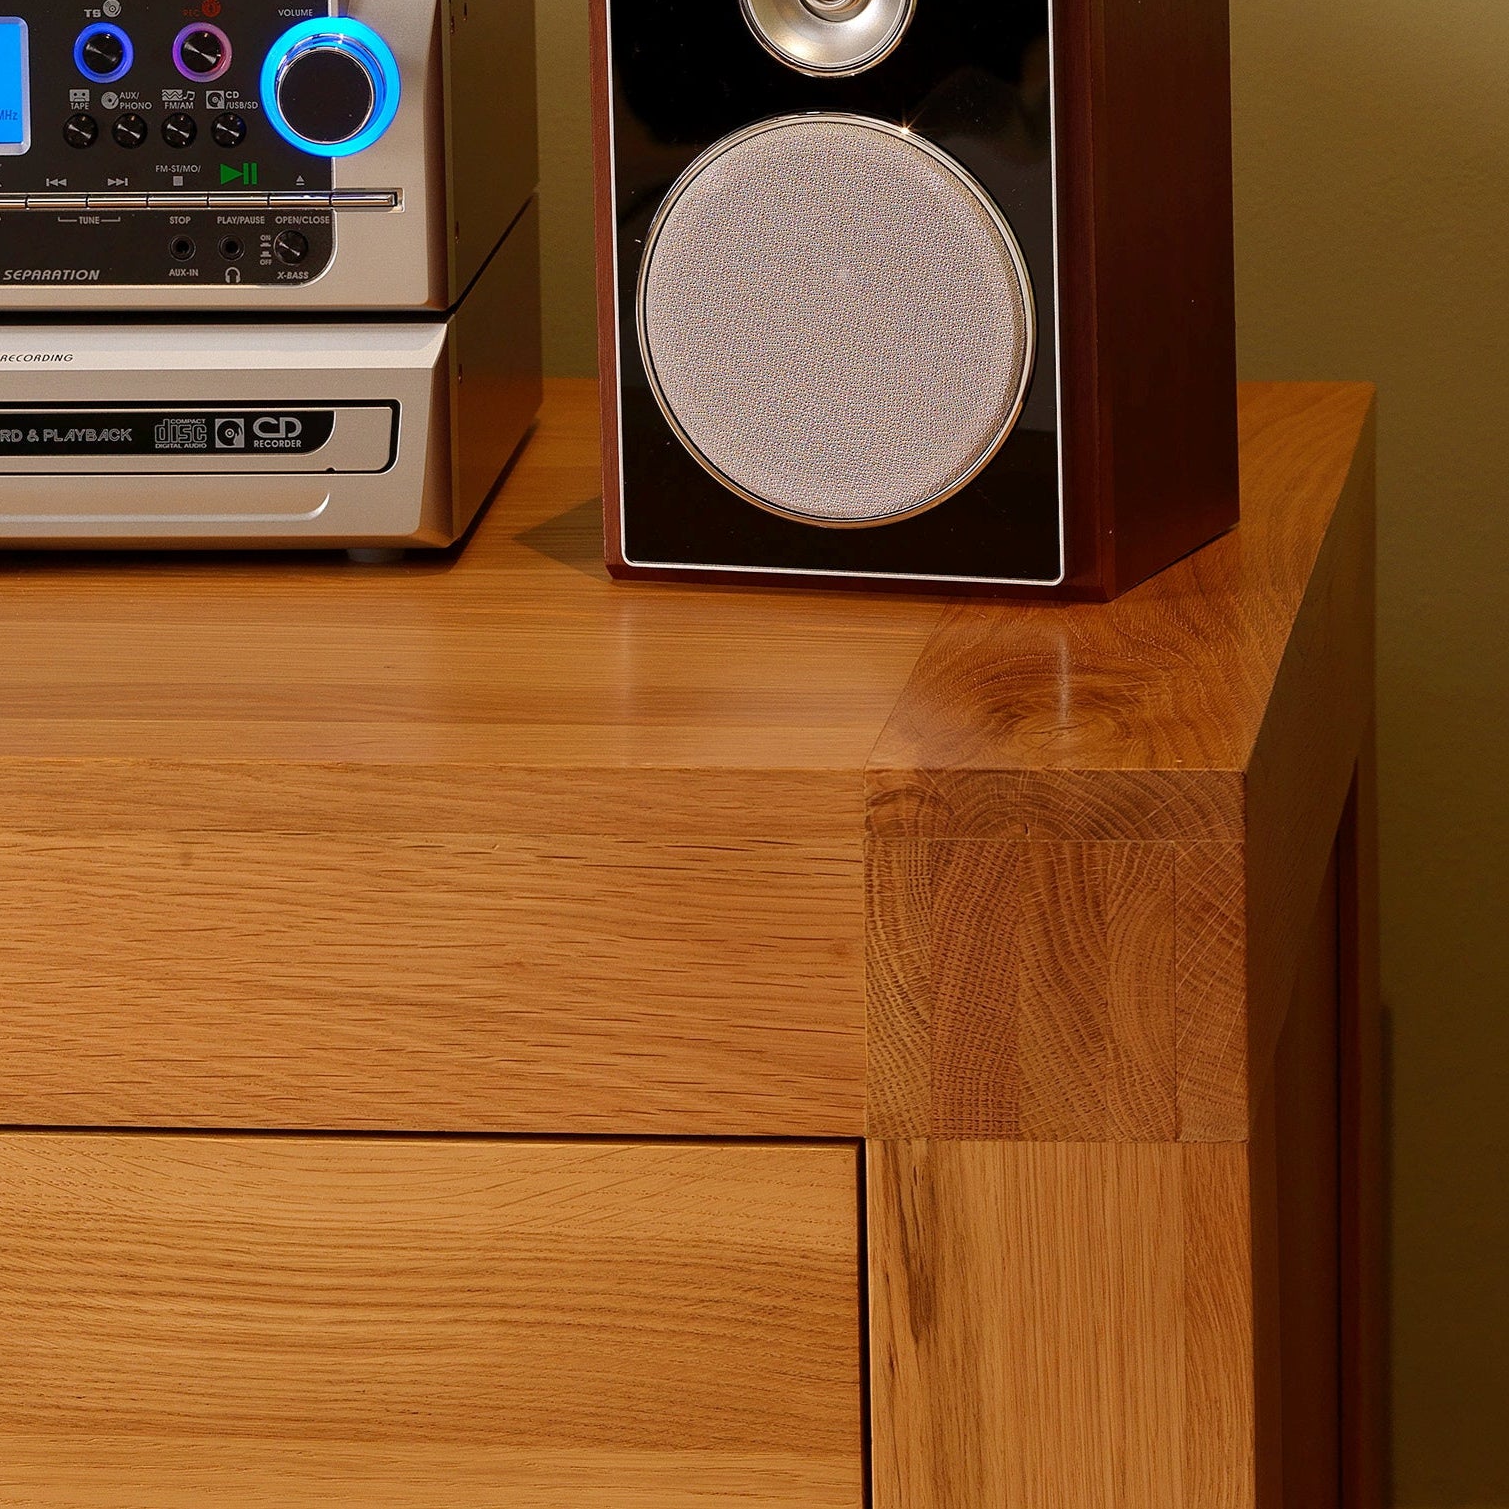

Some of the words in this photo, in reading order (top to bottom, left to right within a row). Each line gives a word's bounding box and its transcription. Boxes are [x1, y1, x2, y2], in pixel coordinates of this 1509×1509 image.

[84, 9, 101, 17] TS
[120, 92, 140, 100] AUX/
[225, 91, 240, 99] CD
[120, 102, 152, 110] PHONO
[164, 102, 194, 110] FM/AM
[225, 102, 259, 110] /USB/SD
[79, 216, 100, 224] TUNE
[170, 216, 191, 224] STOP
[217, 216, 265, 225] PLAY/PAUSE
[275, 216, 330, 224] OPEN/CLOSE
[260, 258, 272, 266] OFF
[3, 270, 100, 280] SEPARATION
[168, 268, 199, 277] AUX-IN
[277, 271, 309, 280] X-BASS
[0, 354, 73, 362] RECORDING
[155, 419, 207, 442] disc
[253, 417, 302, 438] CD
[27, 429, 39, 442] &
[43, 429, 133, 442] PLAYBACK
[254, 440, 301, 448] RECORDER
